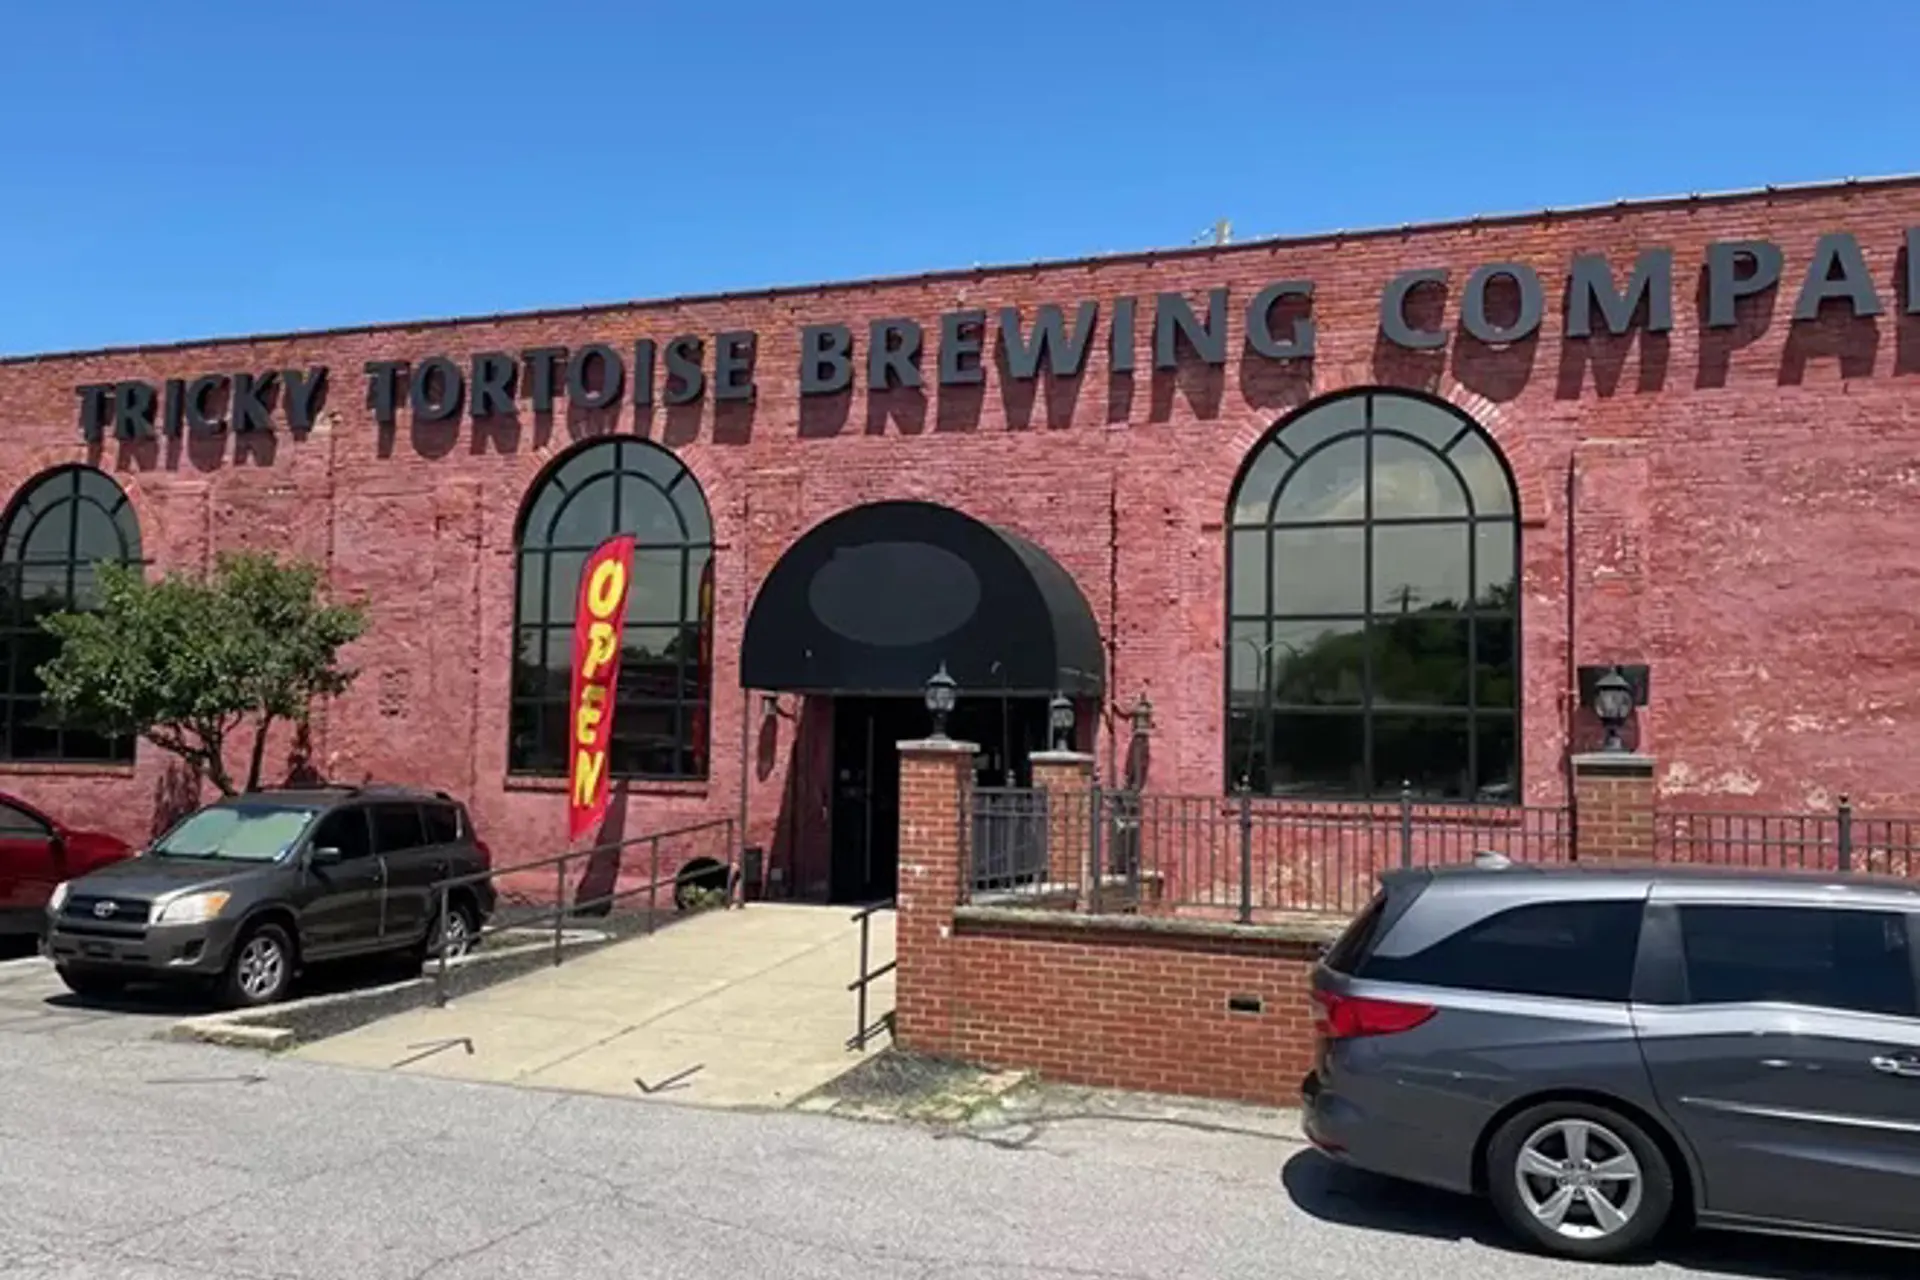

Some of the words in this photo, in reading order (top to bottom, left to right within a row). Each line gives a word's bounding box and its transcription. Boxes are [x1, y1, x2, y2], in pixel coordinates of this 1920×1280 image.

[76, 365, 329, 443] TRICKY
[365, 334, 757, 422] TORTOISE
[800, 280, 1317, 395] BREWING
[1380, 225, 1920, 350] COMPA
[573, 558, 625, 808] OPEN
